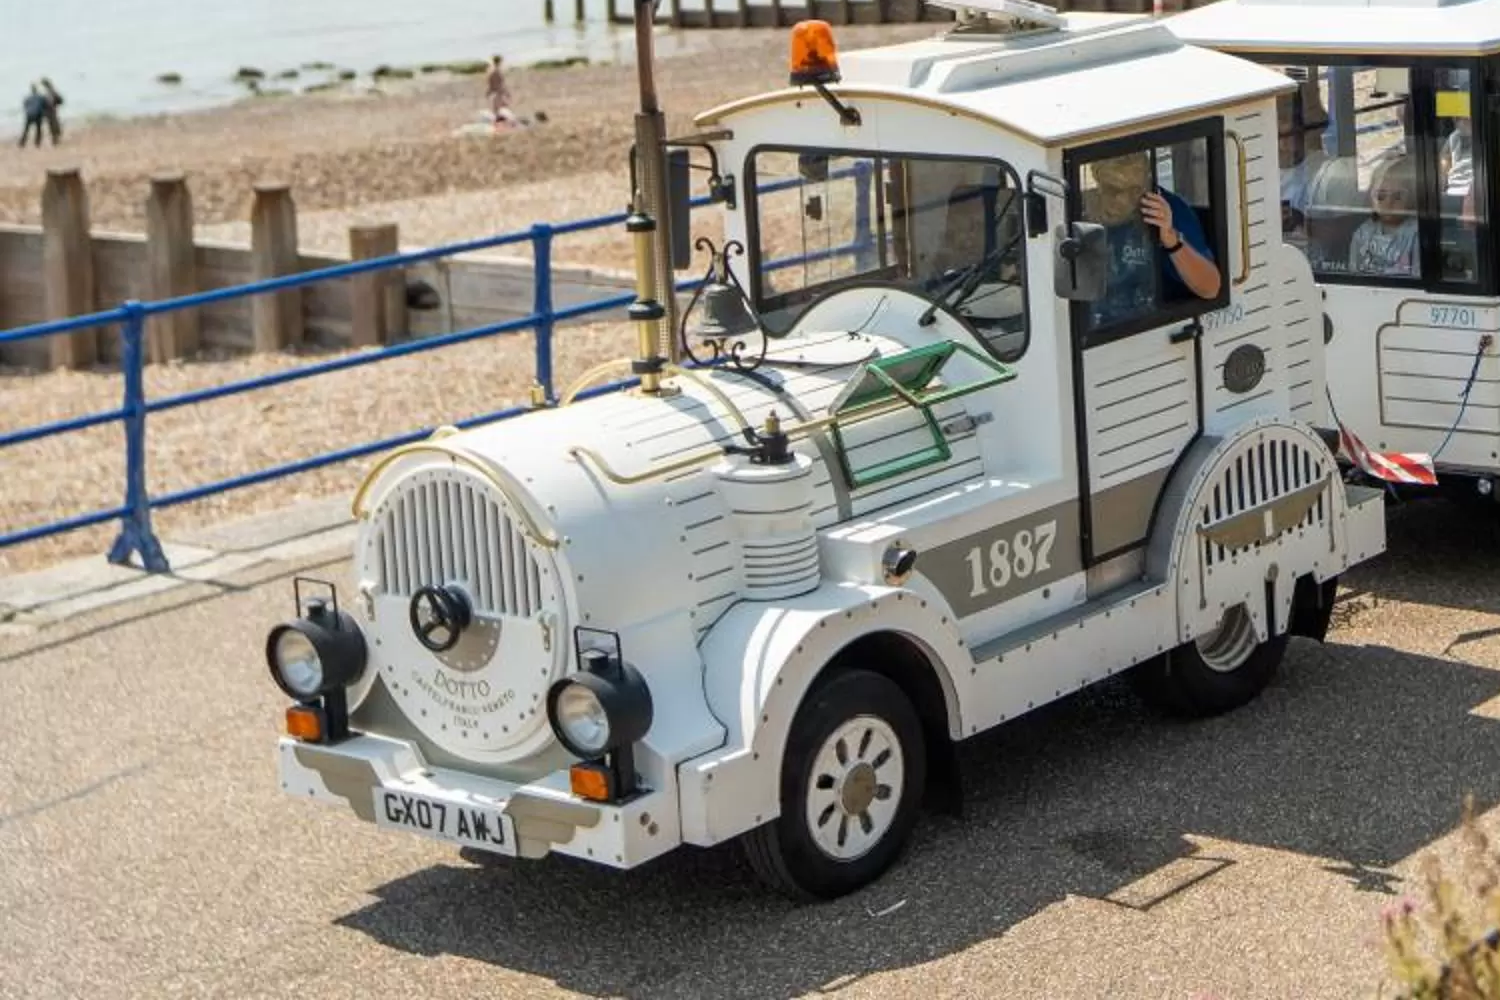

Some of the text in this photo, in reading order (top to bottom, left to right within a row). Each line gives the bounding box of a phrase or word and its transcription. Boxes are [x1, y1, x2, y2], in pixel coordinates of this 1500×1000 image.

[1430, 307, 1475, 325] 97701
[965, 519, 1057, 598] 1887
[434, 669, 491, 700] DOTTO
[383, 792, 505, 845] GX07 AWJ
